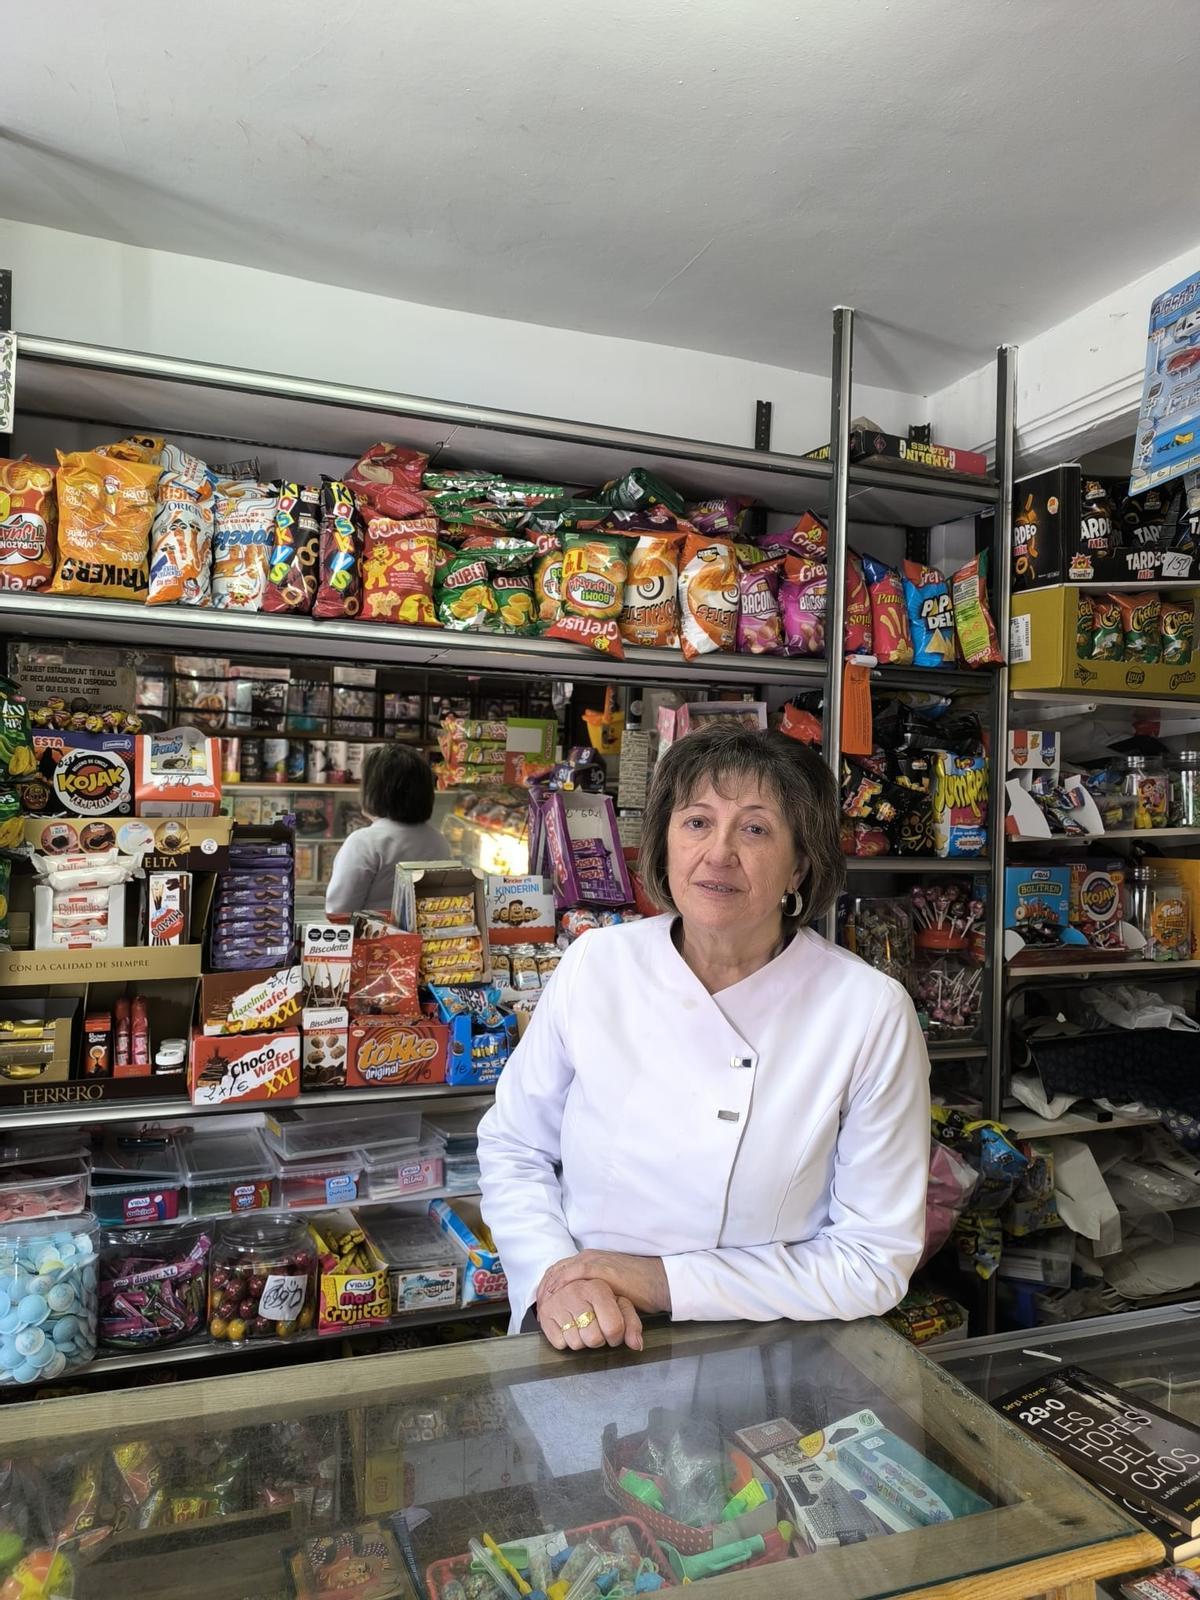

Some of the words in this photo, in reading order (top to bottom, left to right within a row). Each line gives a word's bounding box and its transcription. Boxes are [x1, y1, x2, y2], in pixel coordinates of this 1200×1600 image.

[899, 440, 956, 469] GAMBLING
[60, 557, 150, 593] TRIKERS
[56, 765, 125, 793] KOJAK
[144, 857, 178, 868] ELTA
[495, 883, 540, 896] KINDERINI
[1082, 885, 1117, 906] KOJAK
[151, 909, 185, 938] MIKADO
[9, 963, 32, 973] CON
[35, 962, 47, 972] LA
[49, 961, 93, 971] CALIDAD
[95, 960, 109, 970] DE
[230, 989, 269, 1020] Hazelnut
[255, 986, 289, 1016] wafer
[271, 998, 303, 1028] XXL
[230, 1047, 276, 1079] Choco
[253, 1047, 296, 1079] wafer
[23, 1084, 104, 1105] FERRERO
[263, 1066, 298, 1099] XXL
[348, 1279, 373, 1289] VIDAL
[1041, 1411, 1095, 1442] LES
[1069, 1409, 1153, 1458] HORES
[1098, 1443, 1157, 1475] DEL
[1131, 1448, 1200, 1491] CAOS
